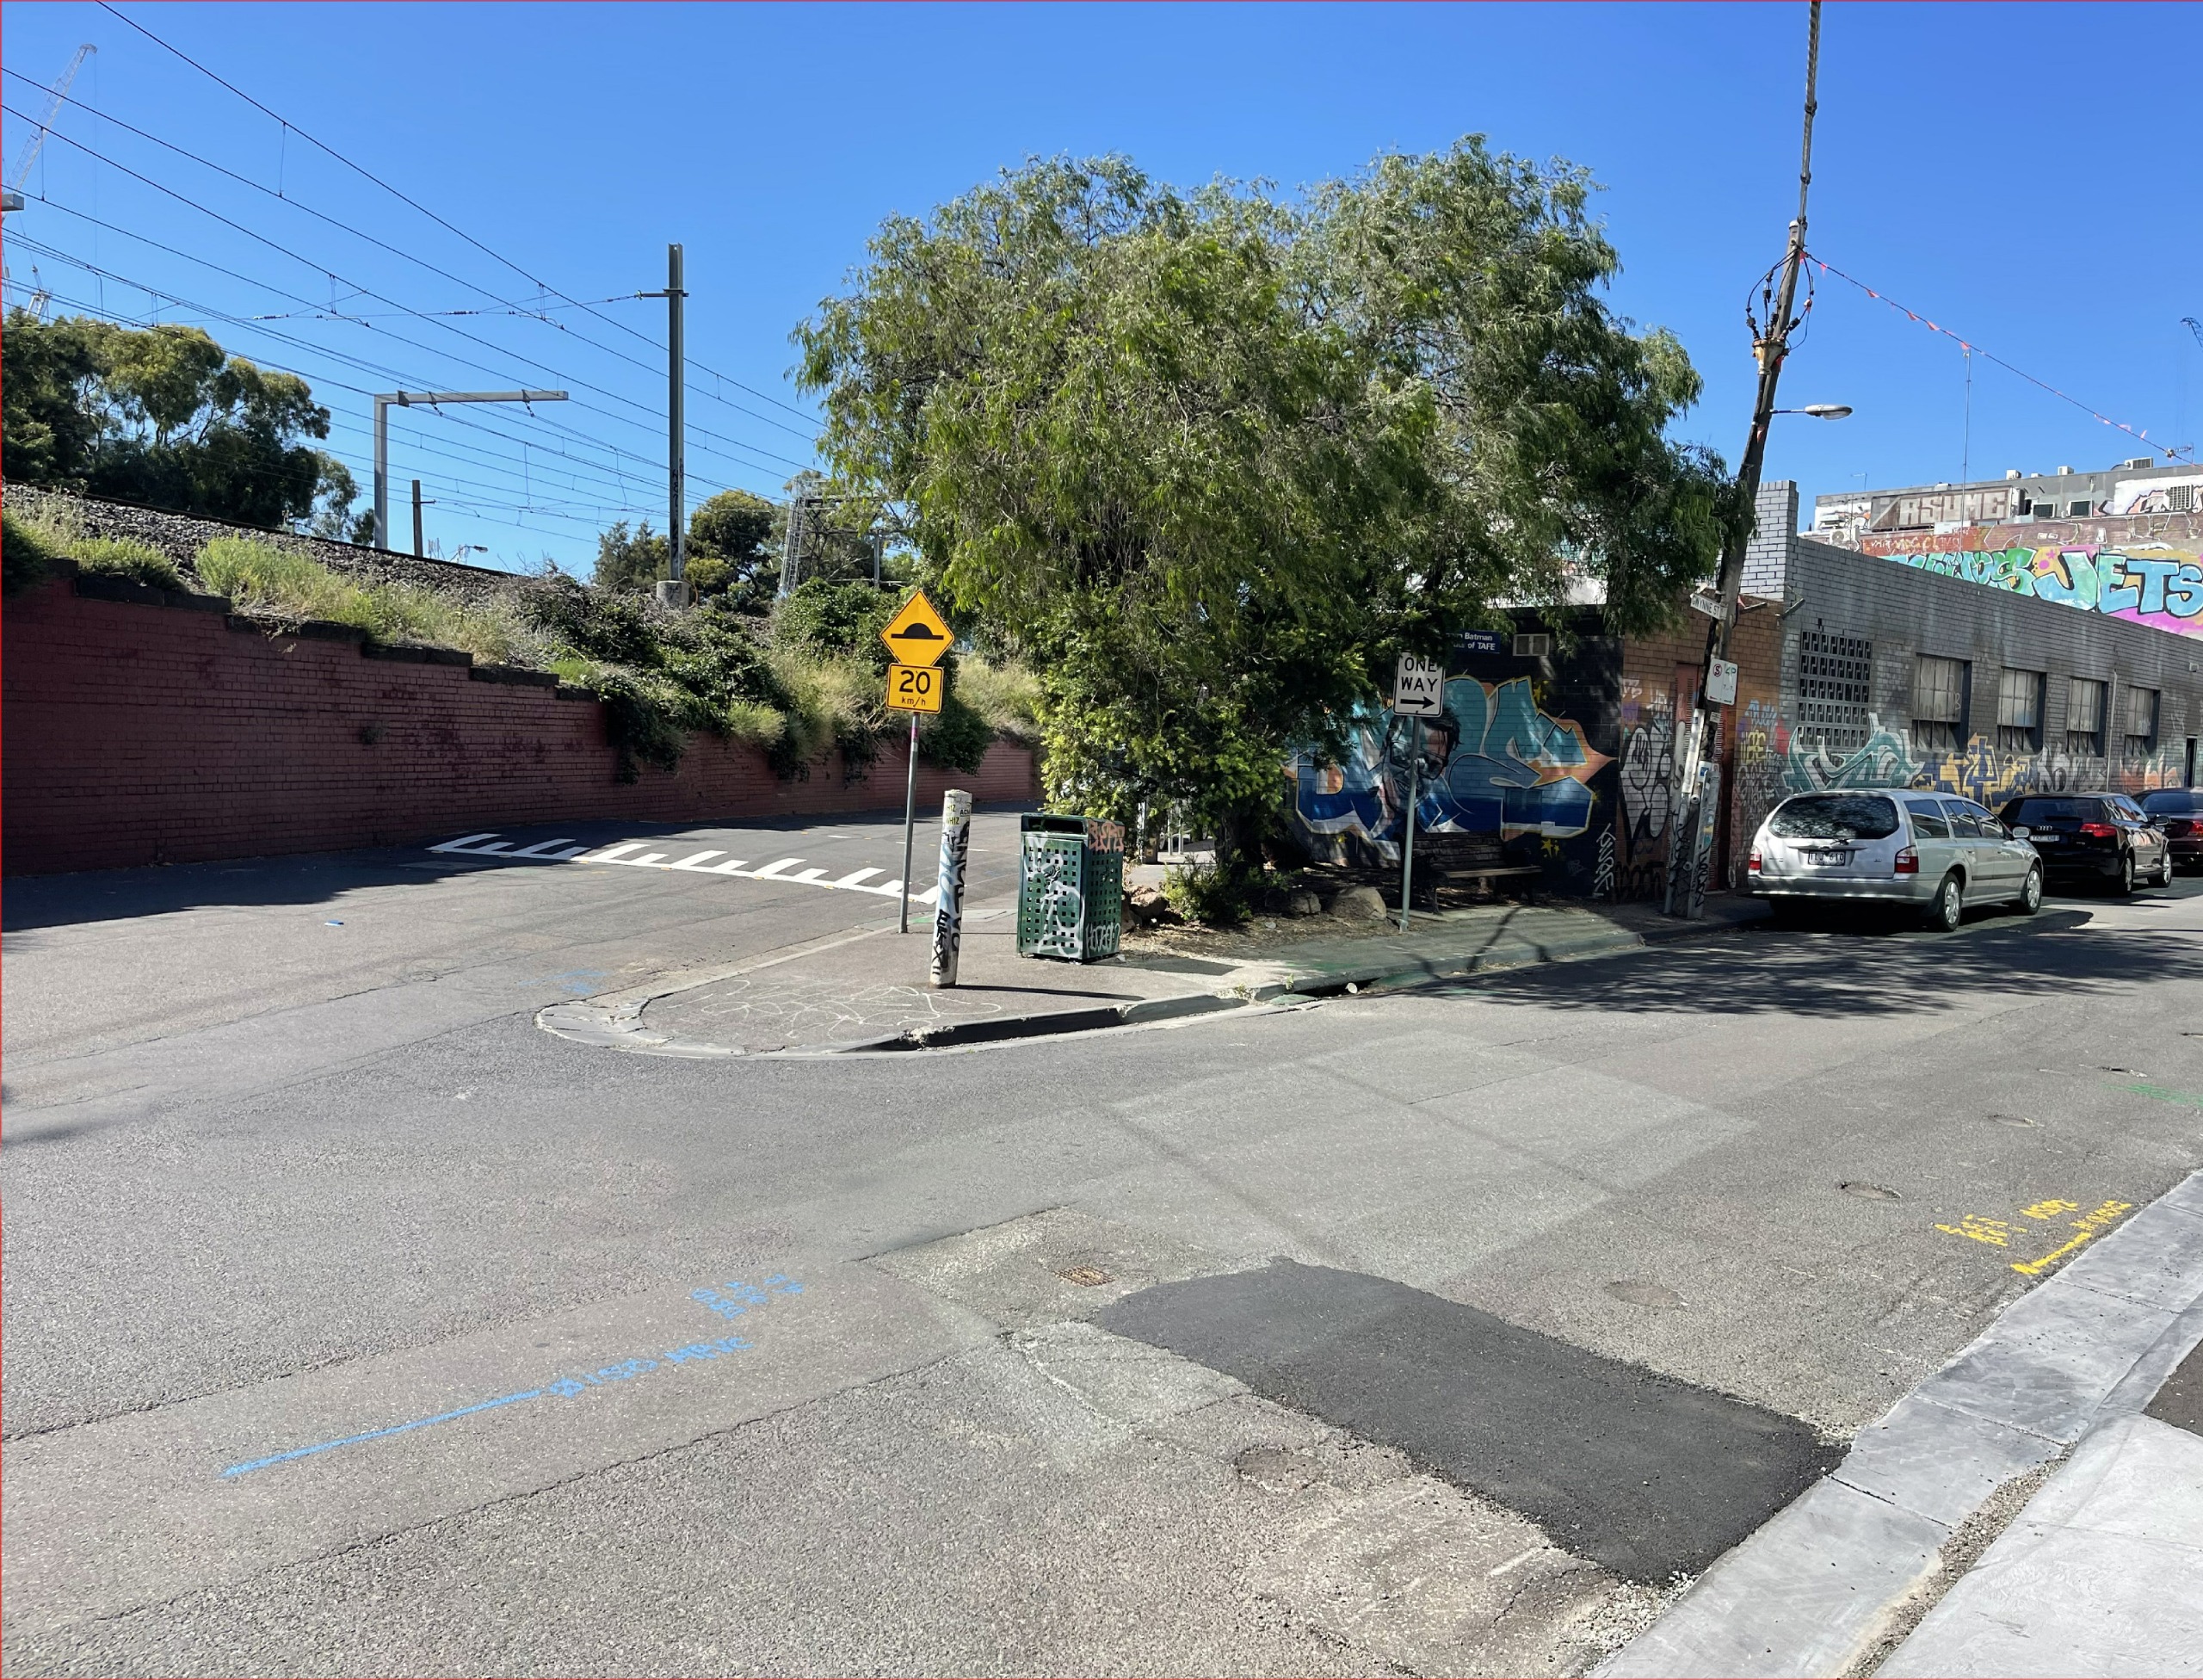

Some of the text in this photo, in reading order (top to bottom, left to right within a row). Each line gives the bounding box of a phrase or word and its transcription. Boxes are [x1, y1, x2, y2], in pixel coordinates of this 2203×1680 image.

[1713, 605, 1720, 616] ST
[1464, 632, 1493, 641] Batman
[1477, 642, 1496, 651] TAFE
[1404, 657, 1437, 673] ONE
[899, 670, 931, 695] 20
[1401, 676, 1438, 692] WAY
[901, 696, 926, 707] km/h
